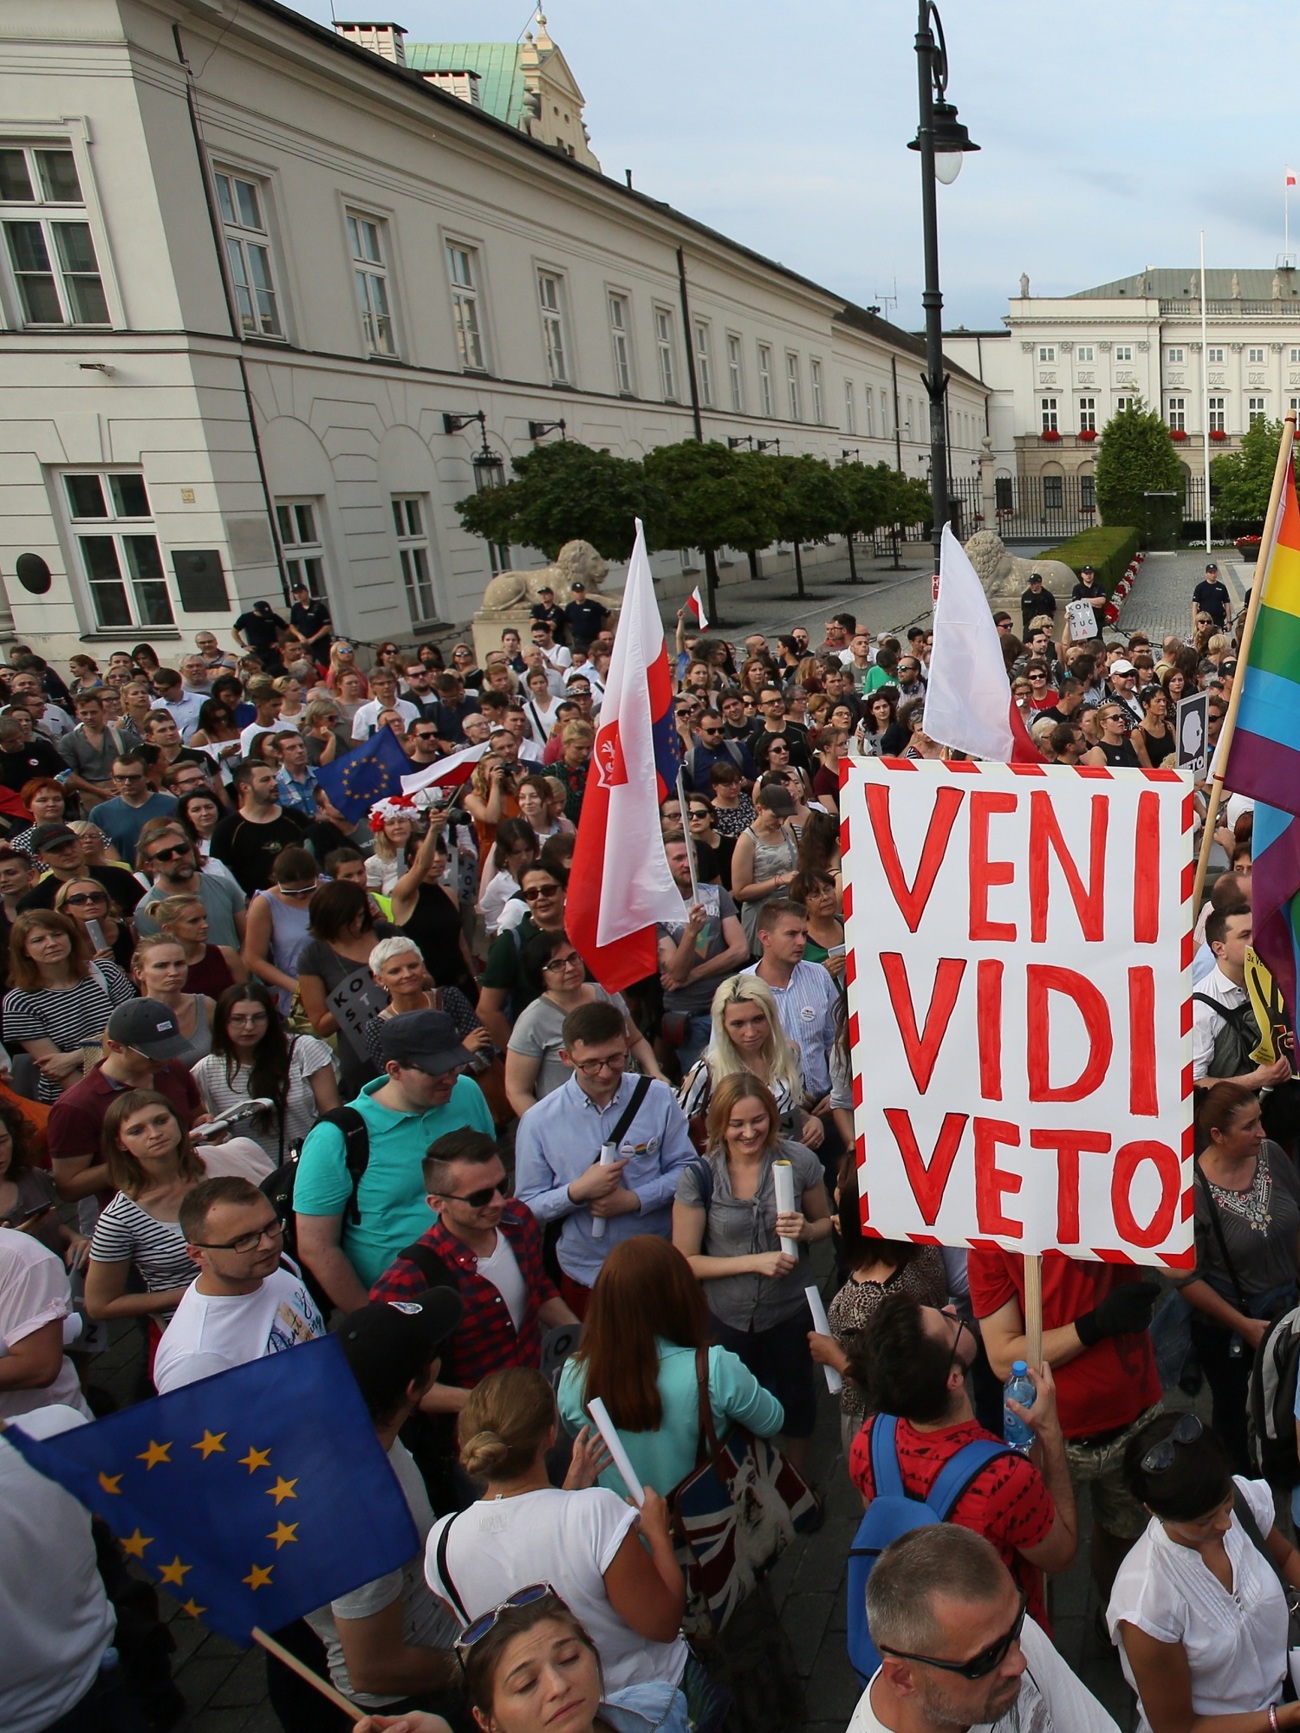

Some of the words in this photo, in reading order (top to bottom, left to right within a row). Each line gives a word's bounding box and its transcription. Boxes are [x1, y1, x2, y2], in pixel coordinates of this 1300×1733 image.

[1072, 619, 1094, 628] TUC
[864, 782, 1161, 944] VENI
[878, 951, 1159, 1118] VIDI
[881, 1108, 1182, 1248] VETO
